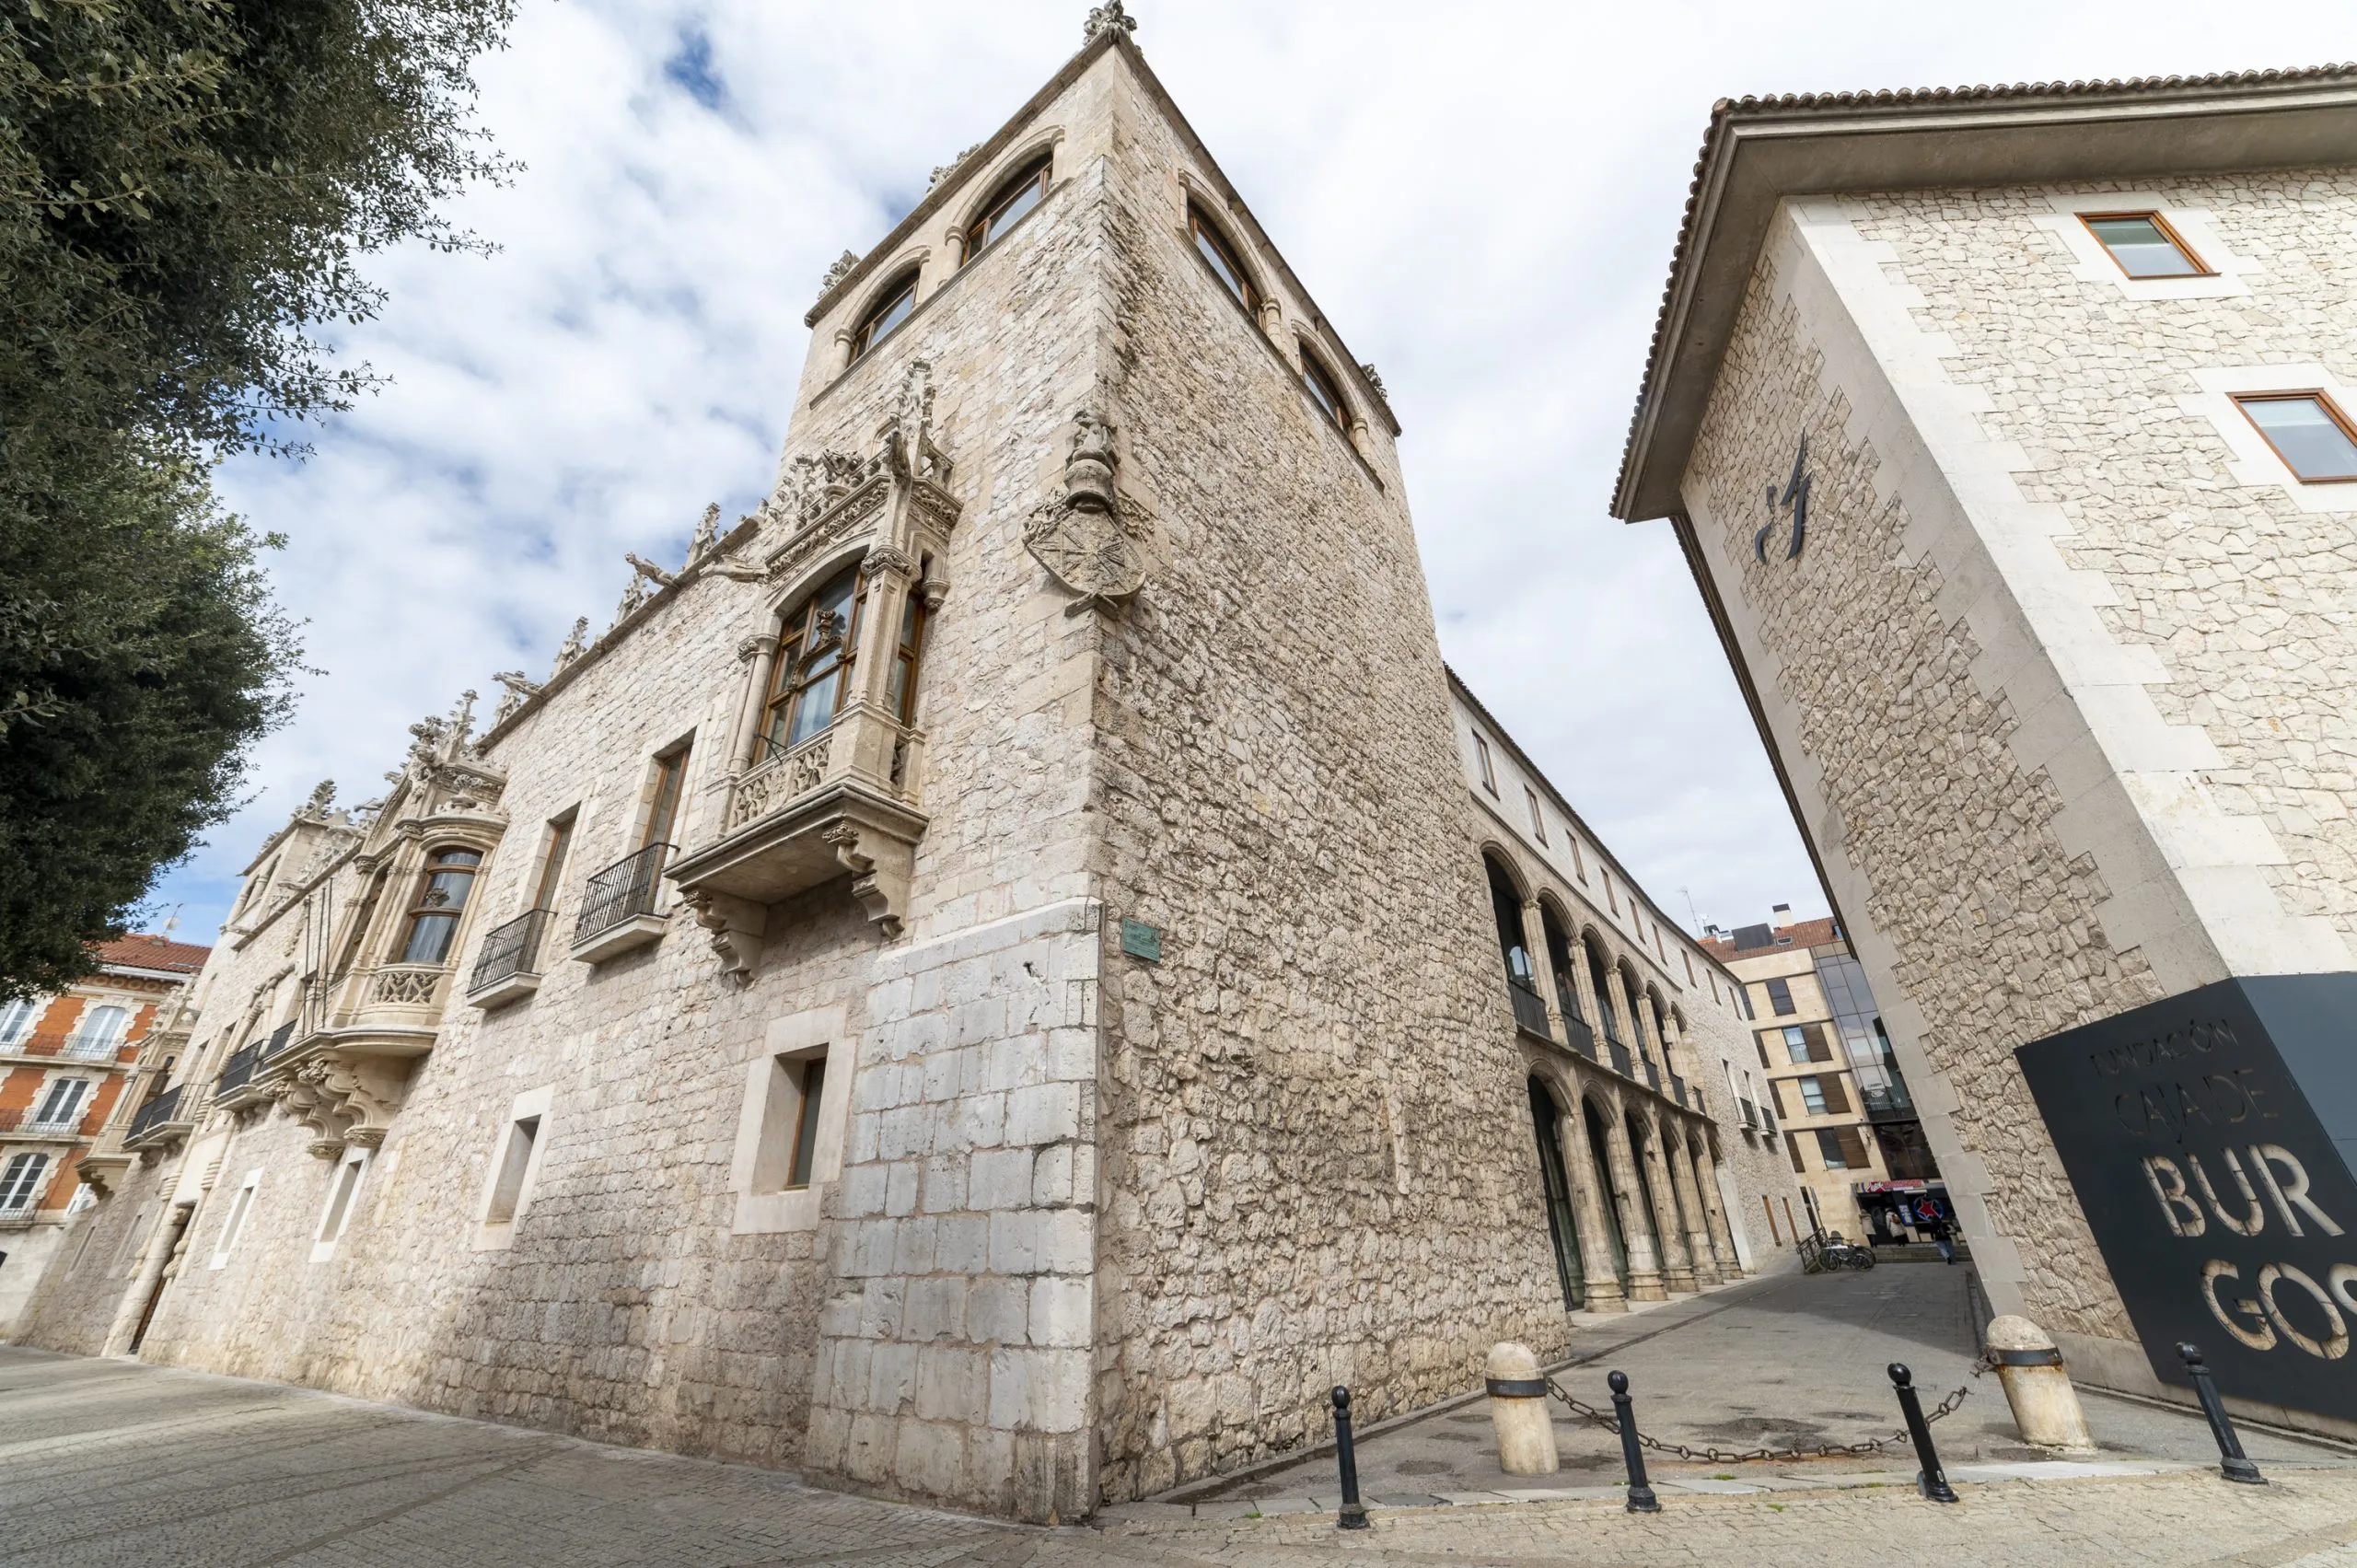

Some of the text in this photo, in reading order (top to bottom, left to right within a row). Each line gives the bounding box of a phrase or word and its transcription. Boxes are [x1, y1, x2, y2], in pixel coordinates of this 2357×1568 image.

[2115, 1068, 2279, 1144] CAJA DE
[2140, 1143, 2345, 1237] BUR
